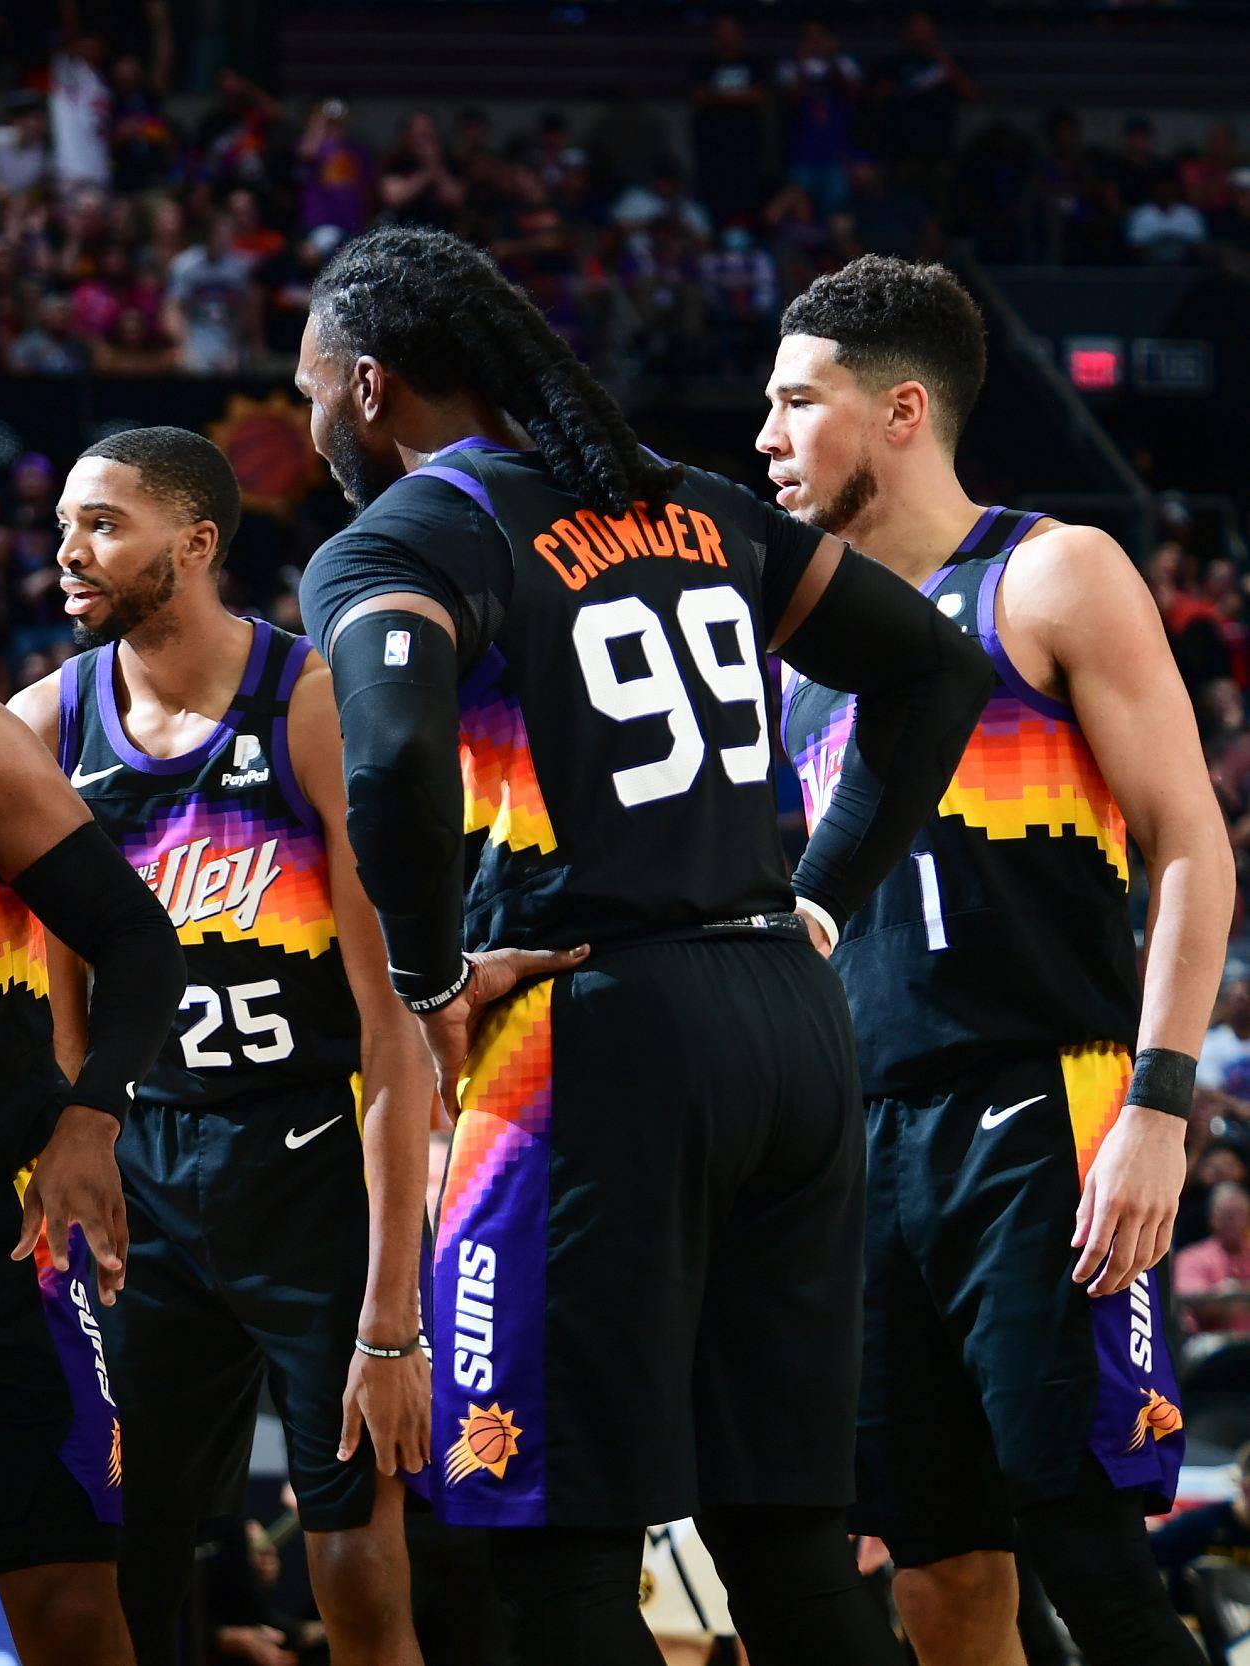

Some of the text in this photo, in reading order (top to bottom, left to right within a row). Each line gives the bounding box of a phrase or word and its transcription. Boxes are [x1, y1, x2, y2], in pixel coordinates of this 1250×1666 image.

[534, 500, 728, 591] CROWDER
[571, 584, 770, 808] 99
[221, 768, 270, 787] PayPal
[136, 861, 161, 881] HE
[910, 851, 949, 951] 1
[178, 978, 295, 1068] 25
[428, 988, 453, 1007] TIME
[453, 1237, 496, 1392] SUNS
[1130, 1270, 1153, 1373] UNS
